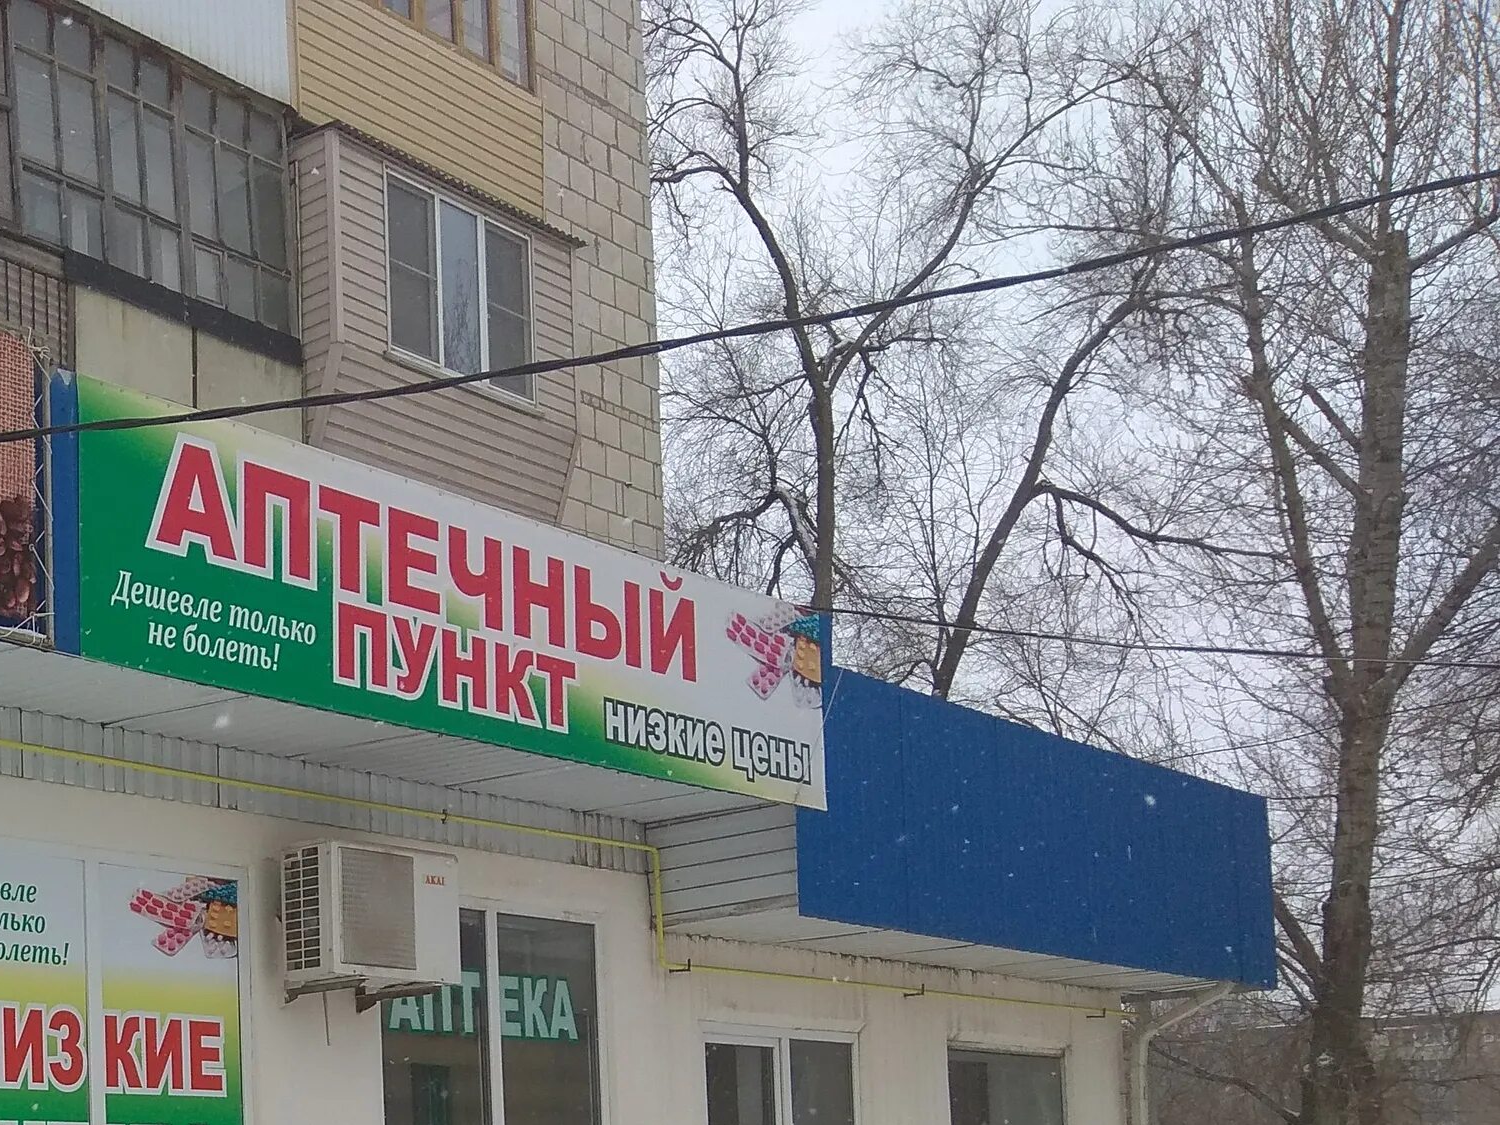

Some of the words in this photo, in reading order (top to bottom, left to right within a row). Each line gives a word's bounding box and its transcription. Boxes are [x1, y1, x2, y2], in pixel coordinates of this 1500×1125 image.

[145, 432, 698, 685] АПТЕЧНЫЙ
[111, 570, 222, 622] Дешевле
[229, 604, 316, 645] только
[148, 622, 176, 648] не
[183, 623, 280, 671] болеть!
[332, 601, 578, 734] ПУНКТ
[425, 875, 445, 886] AKAI
